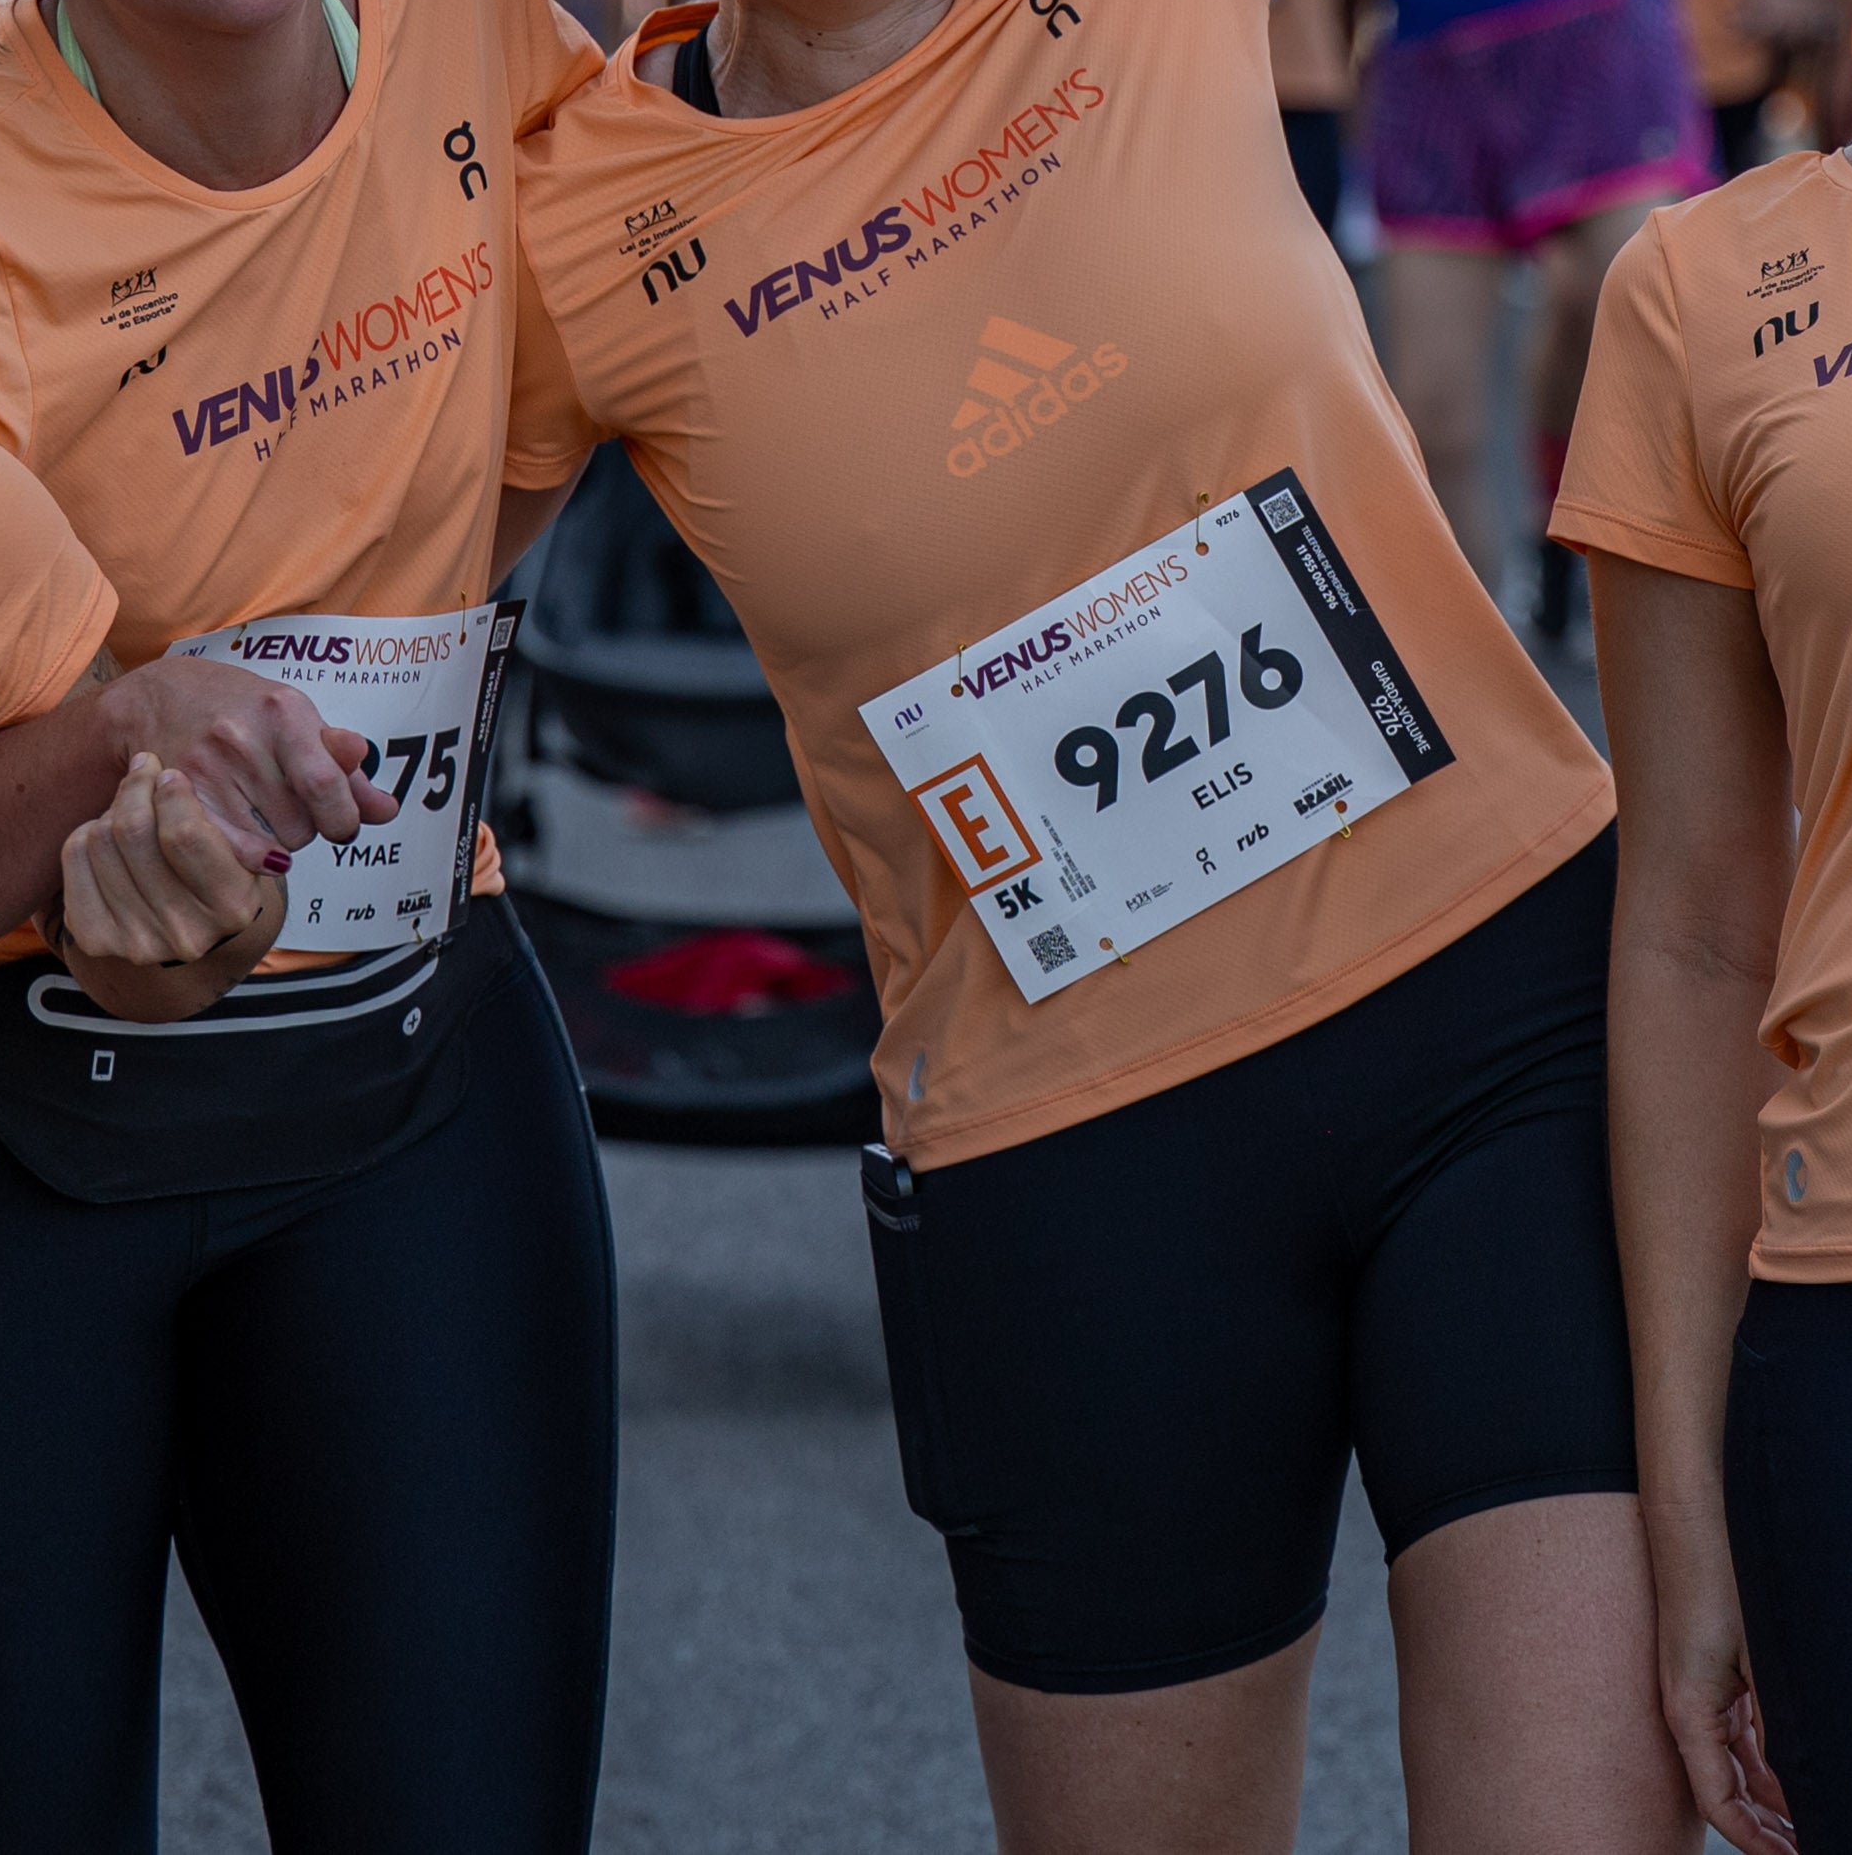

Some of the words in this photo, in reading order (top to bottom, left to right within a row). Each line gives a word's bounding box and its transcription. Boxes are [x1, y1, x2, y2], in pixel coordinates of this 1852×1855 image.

[724, 206, 912, 338] VENUS
[902, 67, 1105, 227] WOMEN'S
[819, 269, 893, 321] HALF
[905, 152, 1062, 269] MARATHON
[642, 237, 707, 306] nu
[100, 312, 117, 326] Lei
[118, 308, 132, 320] de
[132, 292, 180, 315] Incentivo
[118, 320, 132, 331] ao
[320, 241, 494, 372] WOMEN'S
[1753, 300, 1820, 359] nu
[309, 327, 462, 417] MARATHON
[947, 342, 1130, 479] adidas
[1296, 544, 1308, 555] 11
[1301, 553, 1318, 573] 955
[1321, 559, 1332, 572] DE
[1312, 571, 1329, 592] 006
[1322, 589, 1339, 610] 296
[963, 622, 1072, 699] VENUS
[1064, 554, 1188, 639] WOMEN'S
[242, 634, 354, 664] VENUS
[354, 632, 452, 666] WOMEN'S
[1020, 661, 1062, 694] HALF
[1068, 606, 1161, 667] MARATHON
[281, 667, 327, 682] HALF
[334, 669, 421, 684] MARATHON
[894, 703, 923, 730] nu
[1055, 625, 1303, 810] 9276
[1370, 695, 1403, 736] 9276
[1371, 660, 1431, 754] GUARDA-VOLUME
[361, 726, 461, 811] 75
[1191, 762, 1253, 810] ELIS
[1293, 773, 1353, 816] BRASIL
[939, 784, 1010, 871] E
[1236, 823, 1269, 852] rvb
[331, 842, 402, 867] YMAE
[994, 877, 1043, 919] 5K
